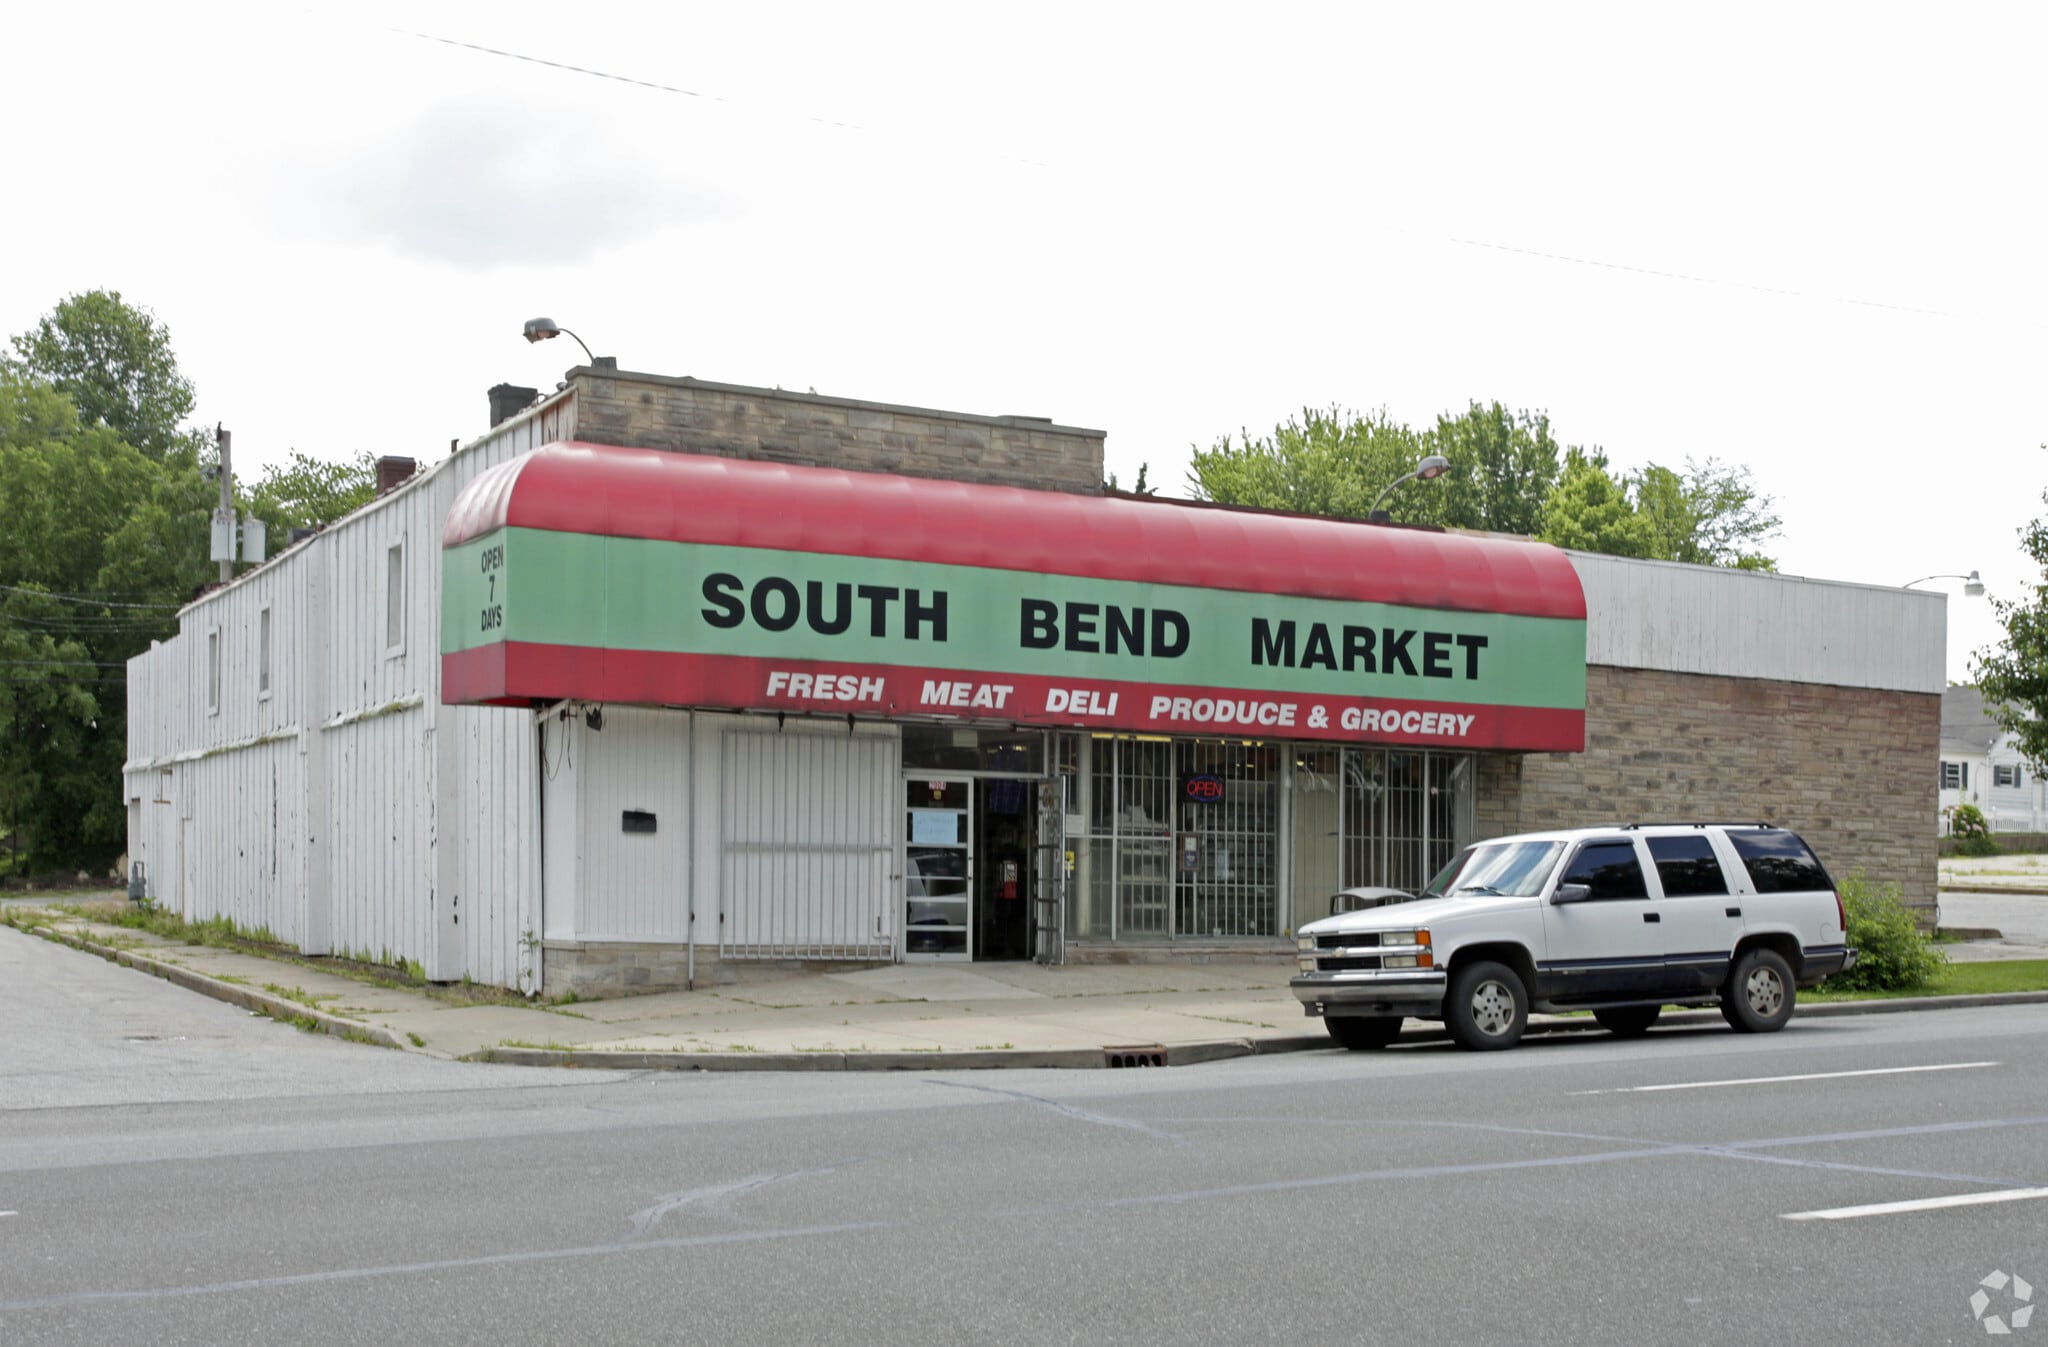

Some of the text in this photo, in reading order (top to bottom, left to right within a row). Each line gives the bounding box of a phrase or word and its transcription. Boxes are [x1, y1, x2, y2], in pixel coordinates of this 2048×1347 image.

[480, 543, 504, 574] OPEN
[488, 574, 496, 603] 7
[481, 604, 503, 632] DAYS
[701, 572, 1489, 681] SOUTH BEND MARKET
[766, 671, 1475, 737] FRESH MEAT DELI PRODUCE & GROCERY
[1186, 781, 1223, 797] OPEN
